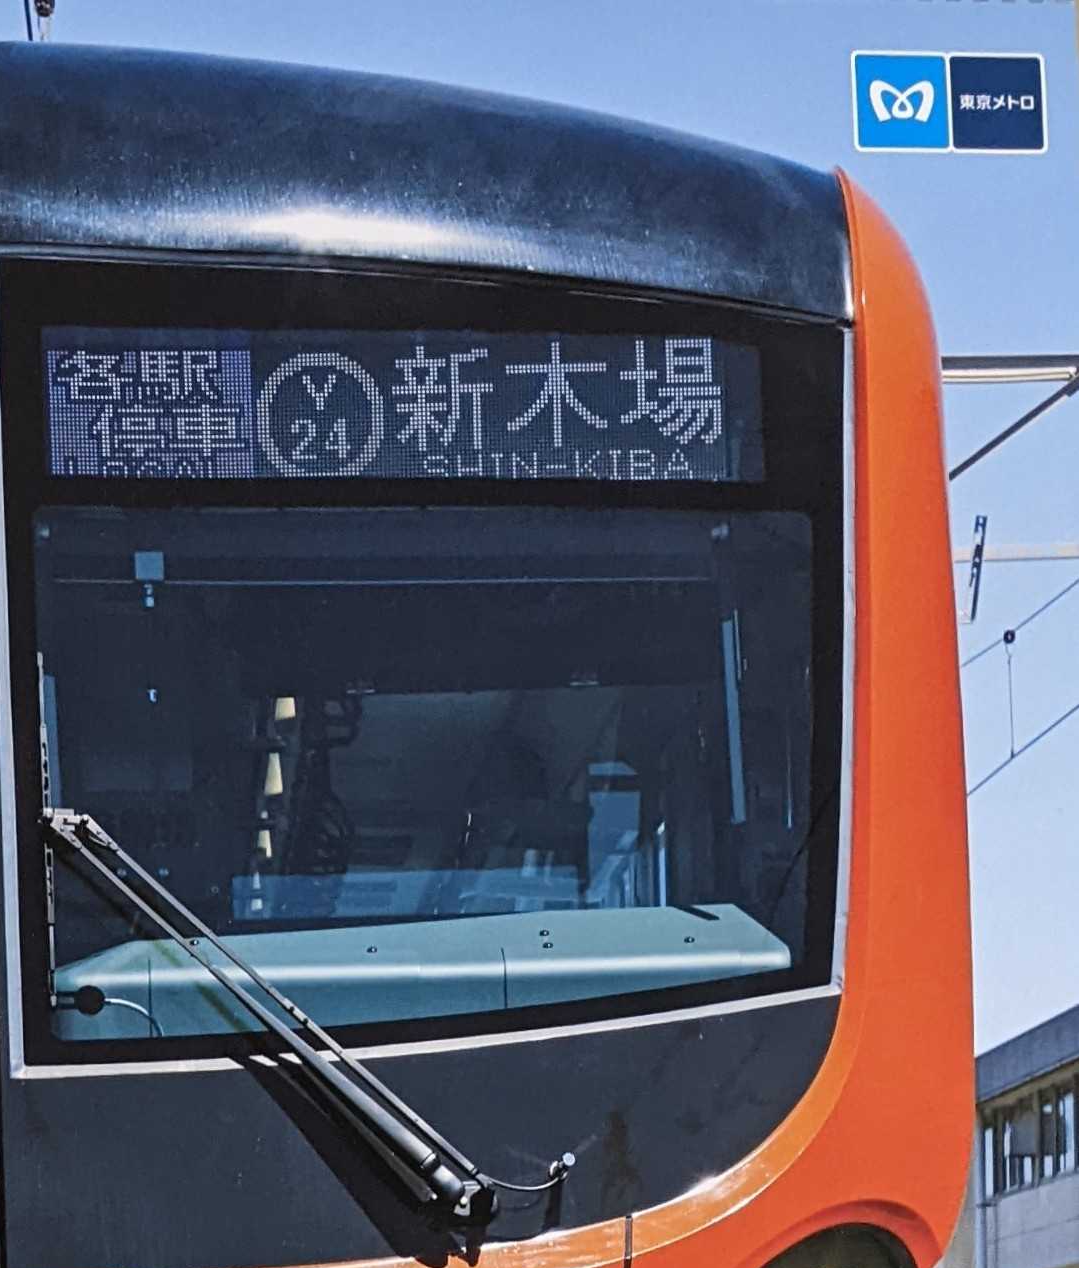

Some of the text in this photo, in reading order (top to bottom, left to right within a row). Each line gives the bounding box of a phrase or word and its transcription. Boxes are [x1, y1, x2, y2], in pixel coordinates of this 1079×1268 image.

[959, 94, 1035, 111] 東京メトロ
[58, 351, 219, 401] 各駅
[302, 373, 337, 412] Y
[391, 337, 723, 450] 新木場
[92, 404, 245, 457] 停車
[291, 417, 350, 461] 24
